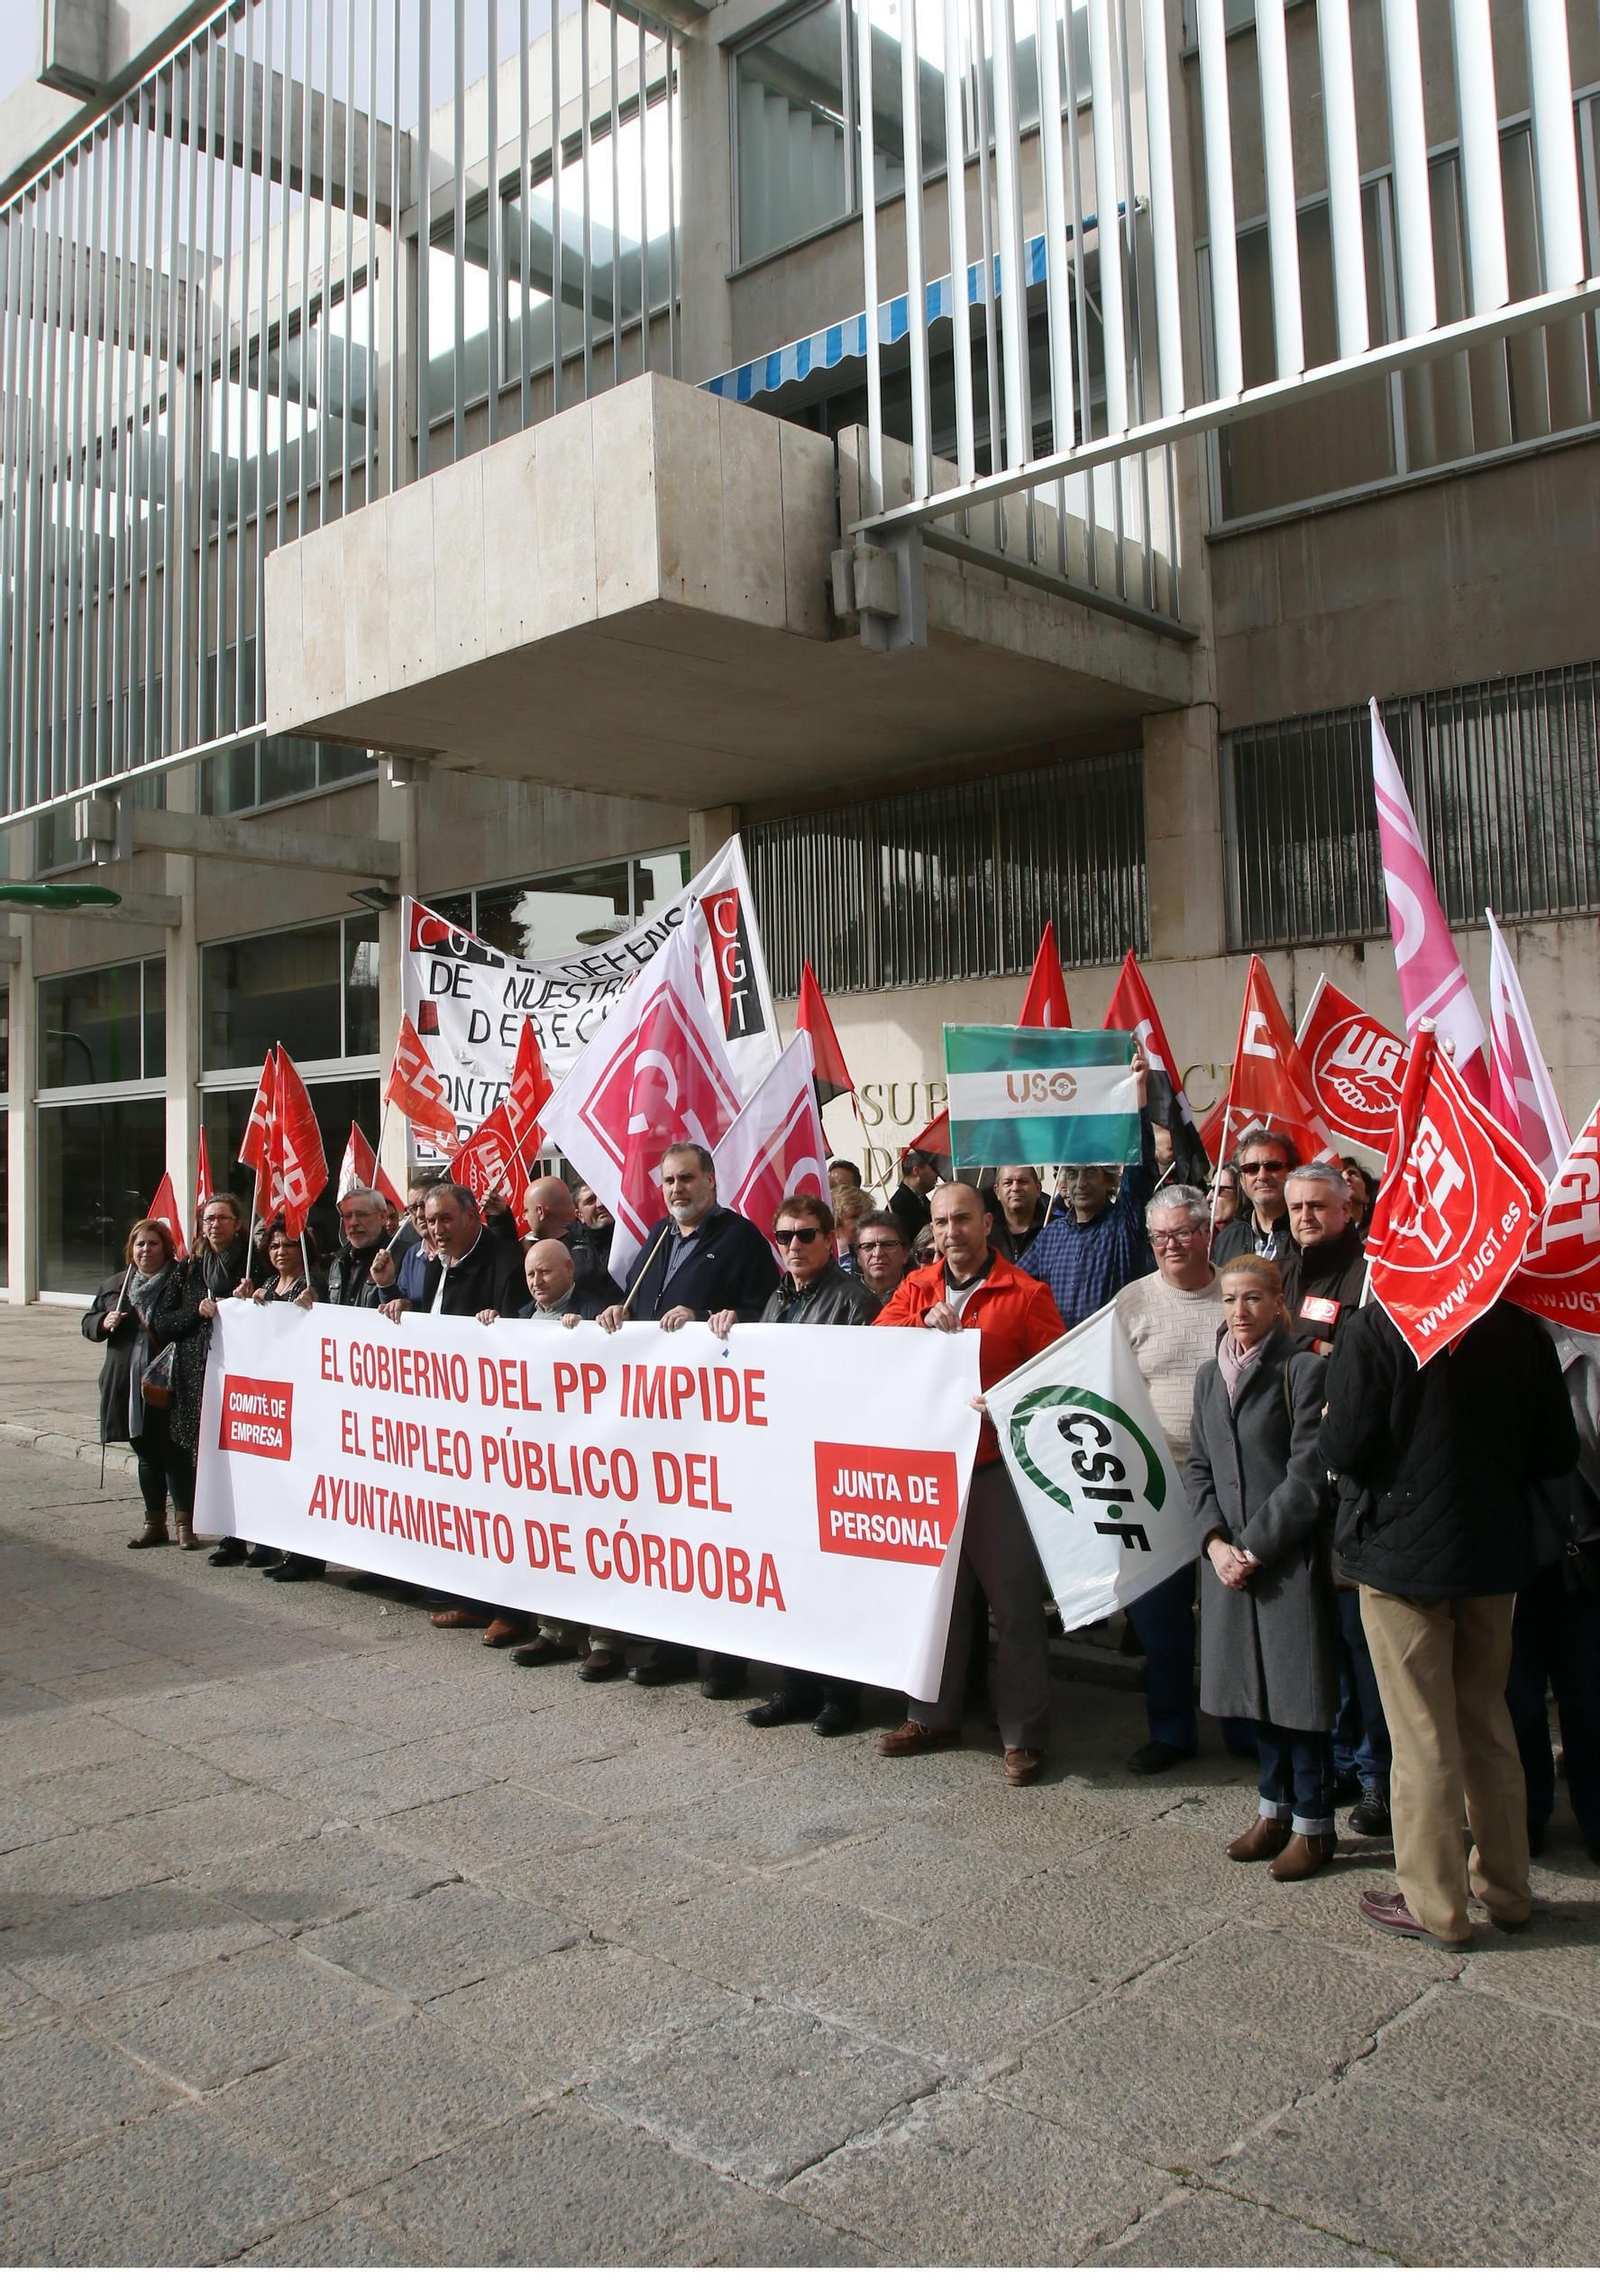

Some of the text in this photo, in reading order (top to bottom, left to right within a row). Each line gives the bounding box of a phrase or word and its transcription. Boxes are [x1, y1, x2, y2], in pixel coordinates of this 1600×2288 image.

[560, 893, 697, 980] DEFENS
[713, 897, 749, 1032] CGT
[429, 960, 473, 1000] DE
[1006, 1072, 1078, 1104] USO
[1414, 1200, 1522, 1338] www.UGT.es
[229, 1391, 287, 1420] COMITÉ DE
[322, 1338, 769, 1426] EL GOBIERNO DEL PP IMPIDE
[230, 1420, 283, 1449] EMPRESA
[341, 1409, 733, 1513] EL EMPLEO PÚBLICO DEL
[832, 1467, 940, 1506] JUNTA DE
[308, 1474, 786, 1612] AYUNTAMIENTO DE CÓRDOBA
[829, 1509, 948, 1550] PERSONAL
